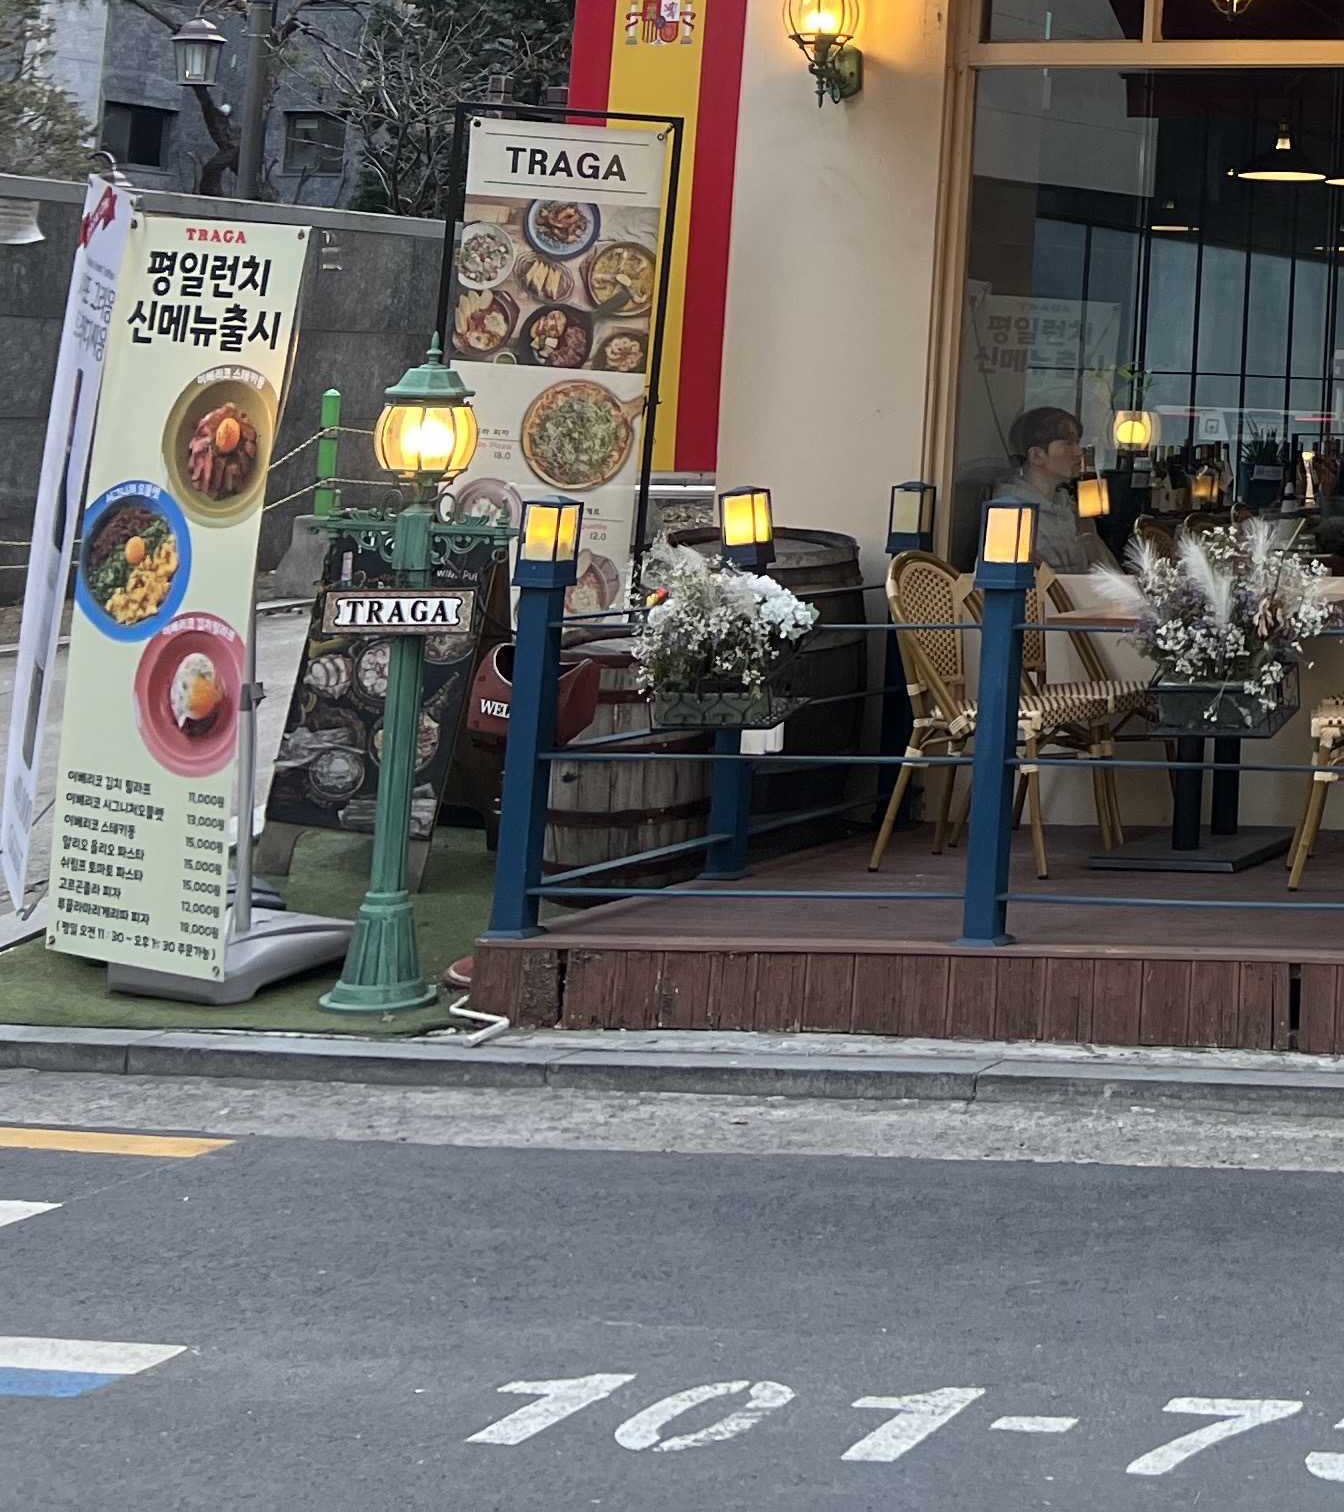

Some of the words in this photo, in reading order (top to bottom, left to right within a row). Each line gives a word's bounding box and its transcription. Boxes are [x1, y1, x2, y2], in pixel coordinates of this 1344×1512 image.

[506, 146, 627, 181] TRAGA
[186, 228, 247, 244] TRAGA
[147, 251, 272, 298] 평일런치
[127, 300, 282, 352] 신메뉴출시
[494, 451, 511, 460] 18.0
[589, 532, 606, 540] 12.0
[345, 600, 449, 623] TRAGA
[480, 698, 510, 719] WEL
[118, 846, 144, 861] 파스타
[116, 866, 143, 881] 파스타
[102, 885, 121, 899] 피자
[131, 911, 150, 925] 피자
